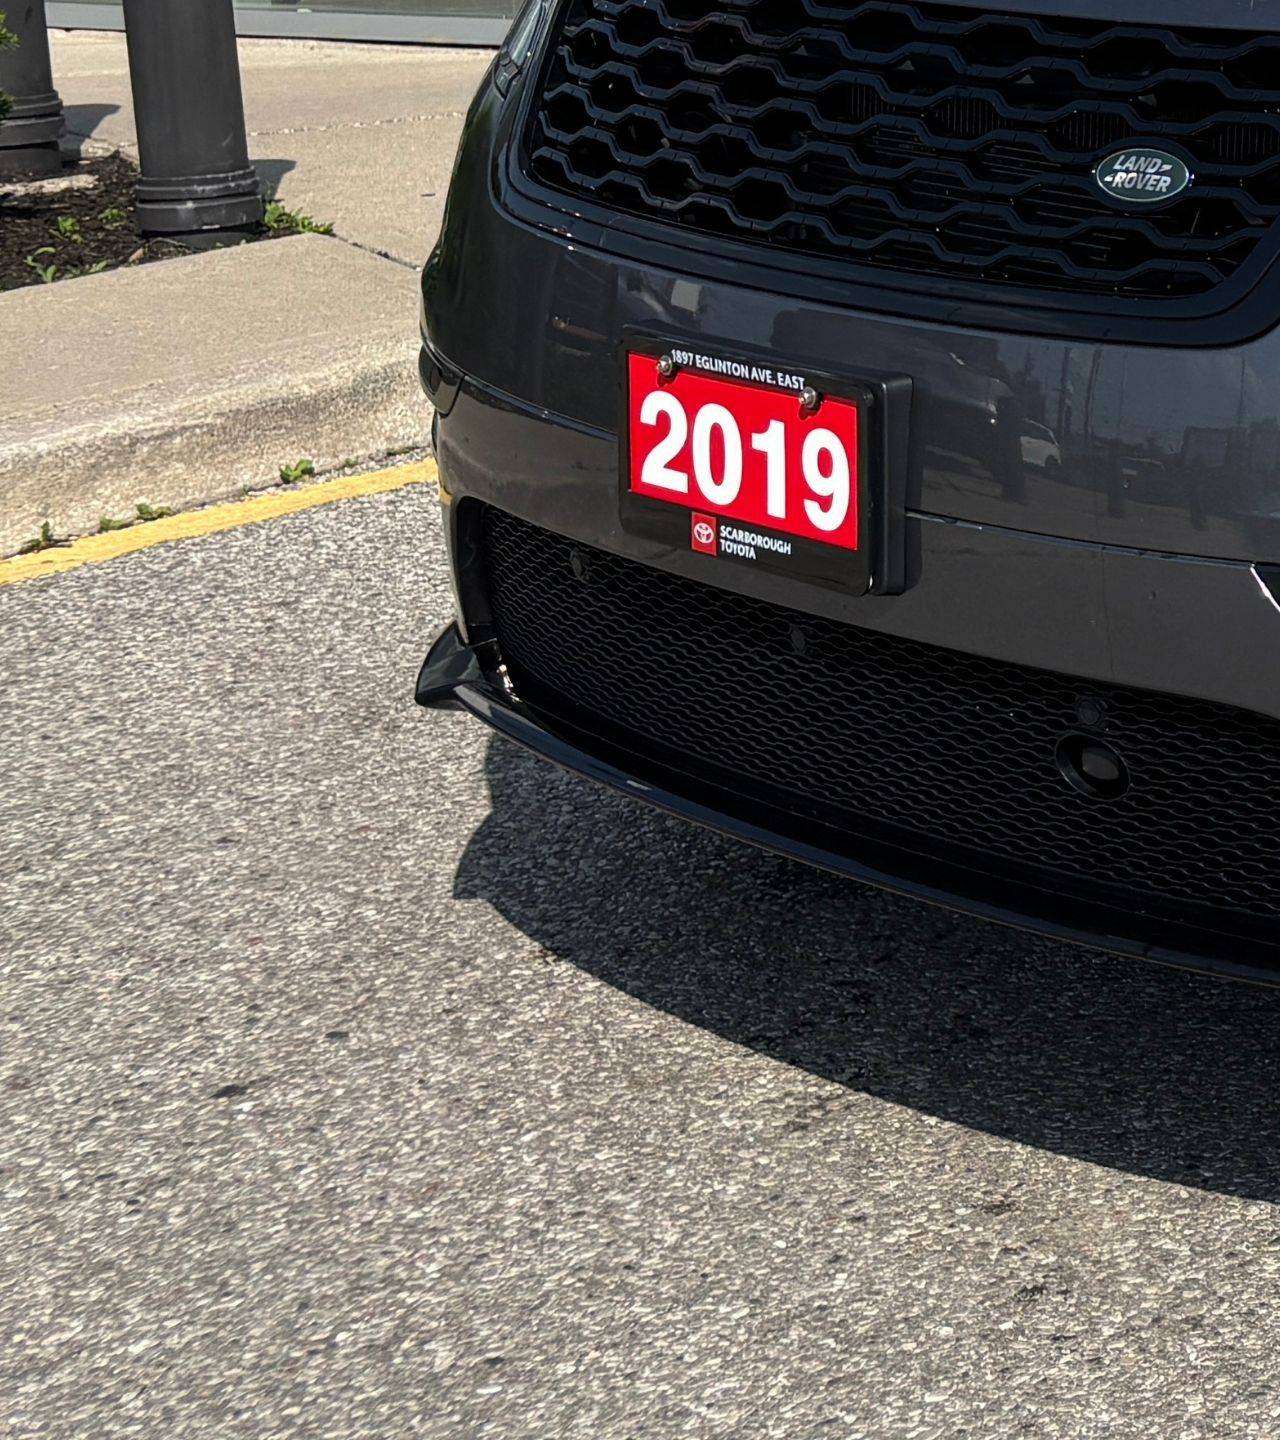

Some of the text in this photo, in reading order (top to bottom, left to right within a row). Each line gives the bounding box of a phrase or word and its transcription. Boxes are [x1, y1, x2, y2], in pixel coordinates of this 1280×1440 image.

[671, 349, 805, 391] 1897 EGLINTON AVE. EAST
[640, 390, 850, 532] 2019
[720, 525, 792, 555] SCARBOROUGH
[720, 539, 756, 560] TOYOTA
